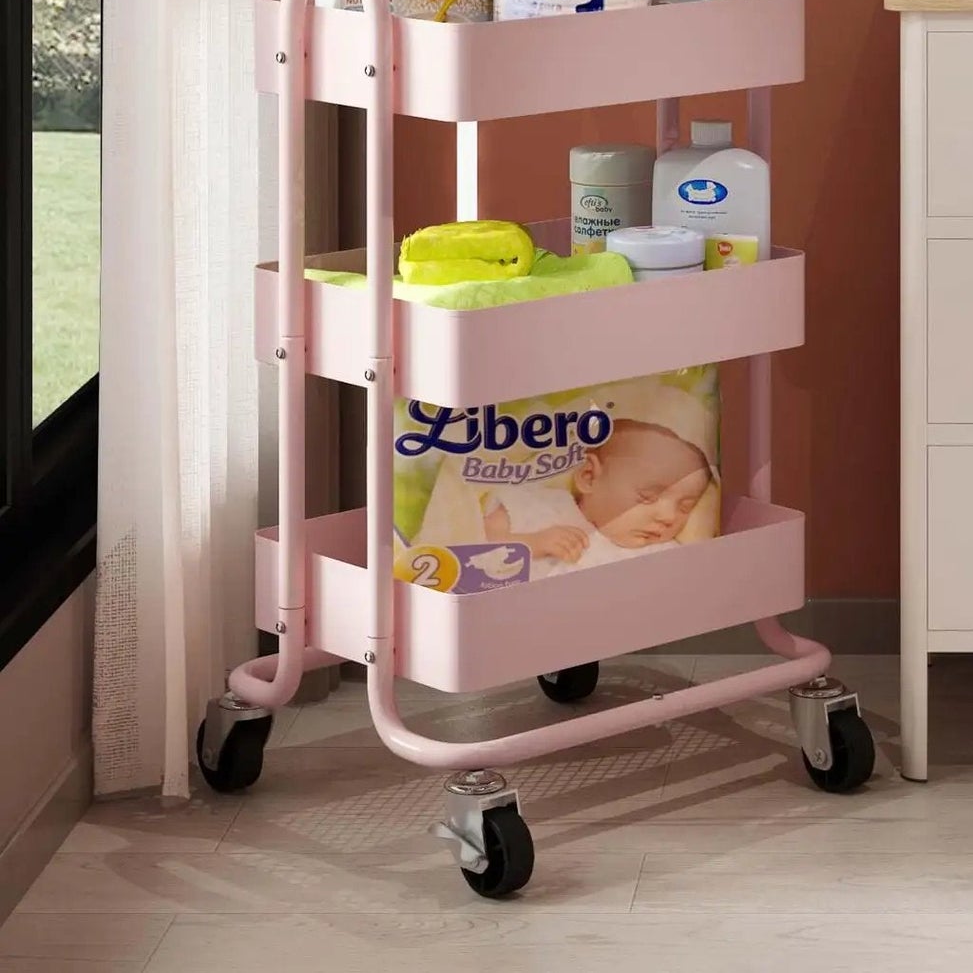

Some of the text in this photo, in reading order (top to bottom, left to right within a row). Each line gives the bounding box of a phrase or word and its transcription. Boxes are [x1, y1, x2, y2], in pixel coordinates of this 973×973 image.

[395, 399, 612, 456] Libero
[462, 443, 585, 484] Baby Soft
[411, 553, 441, 587] 2
